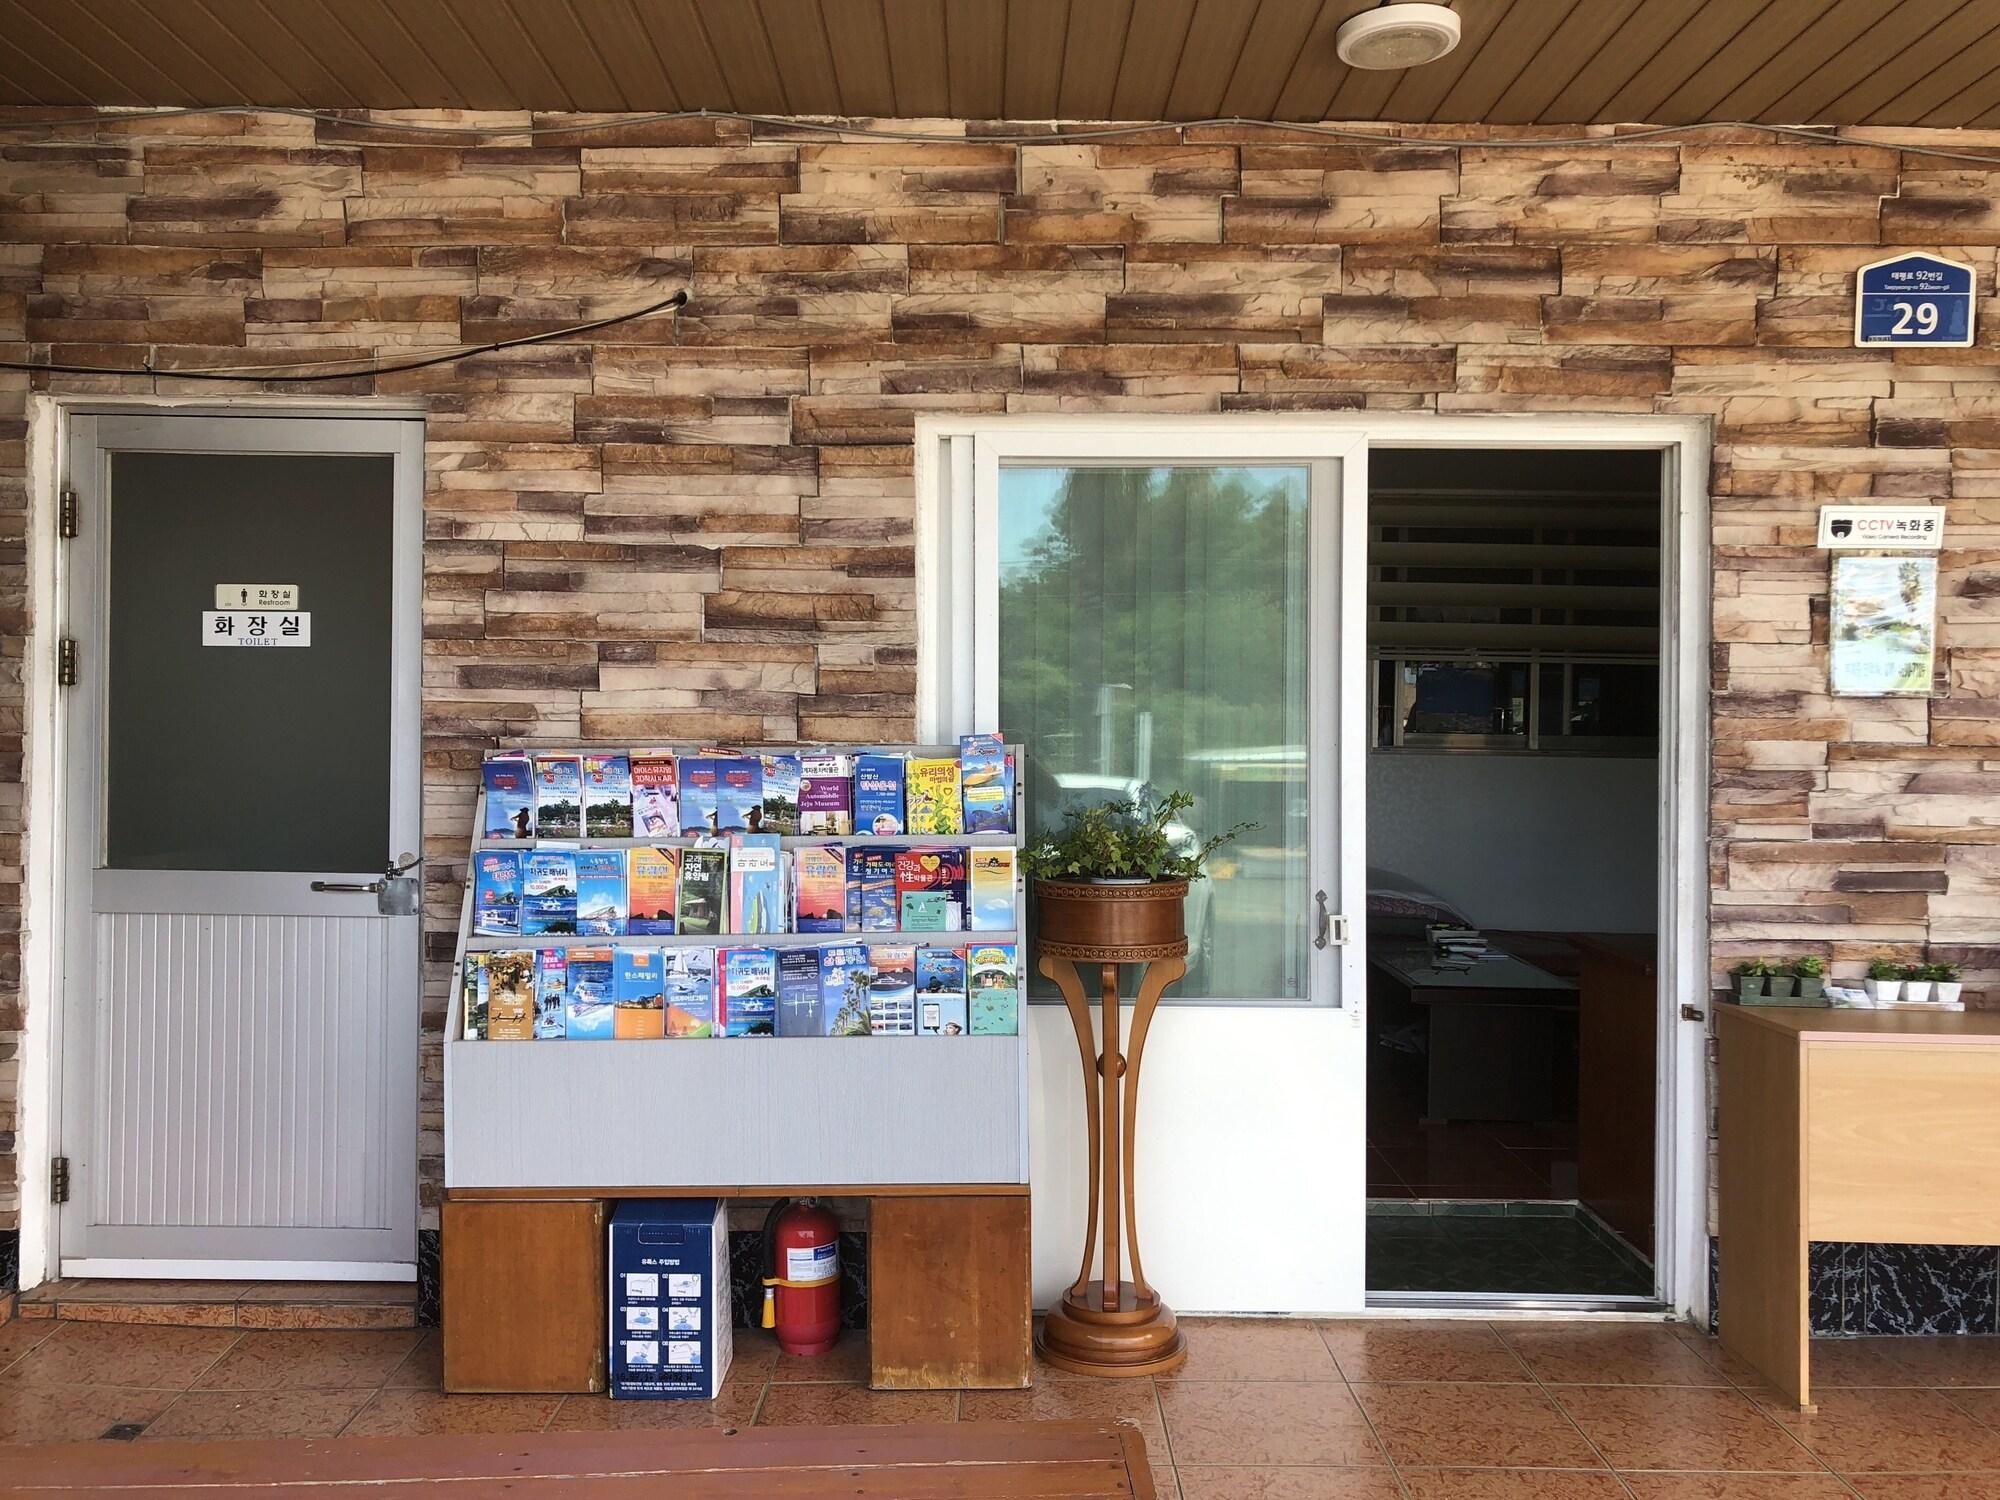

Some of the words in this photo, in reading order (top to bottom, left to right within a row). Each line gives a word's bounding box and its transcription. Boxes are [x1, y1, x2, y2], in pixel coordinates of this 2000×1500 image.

[1916, 270, 1943, 281] 92번길
[1891, 302, 1939, 336] 29
[1857, 519, 1894, 531] CCTV
[1896, 519, 1935, 532] 녹화중
[258, 589, 291, 599] 화장실
[214, 616, 300, 636] 화장실
[238, 638, 278, 646] TOILET
[919, 766, 954, 777] 유리의성
[685, 855, 702, 863] 교래
[685, 863, 701, 872] 자연
[897, 860, 921, 871] 건강과
[685, 872, 709, 881] 휴양림
[900, 871, 933, 883] 性박물관
